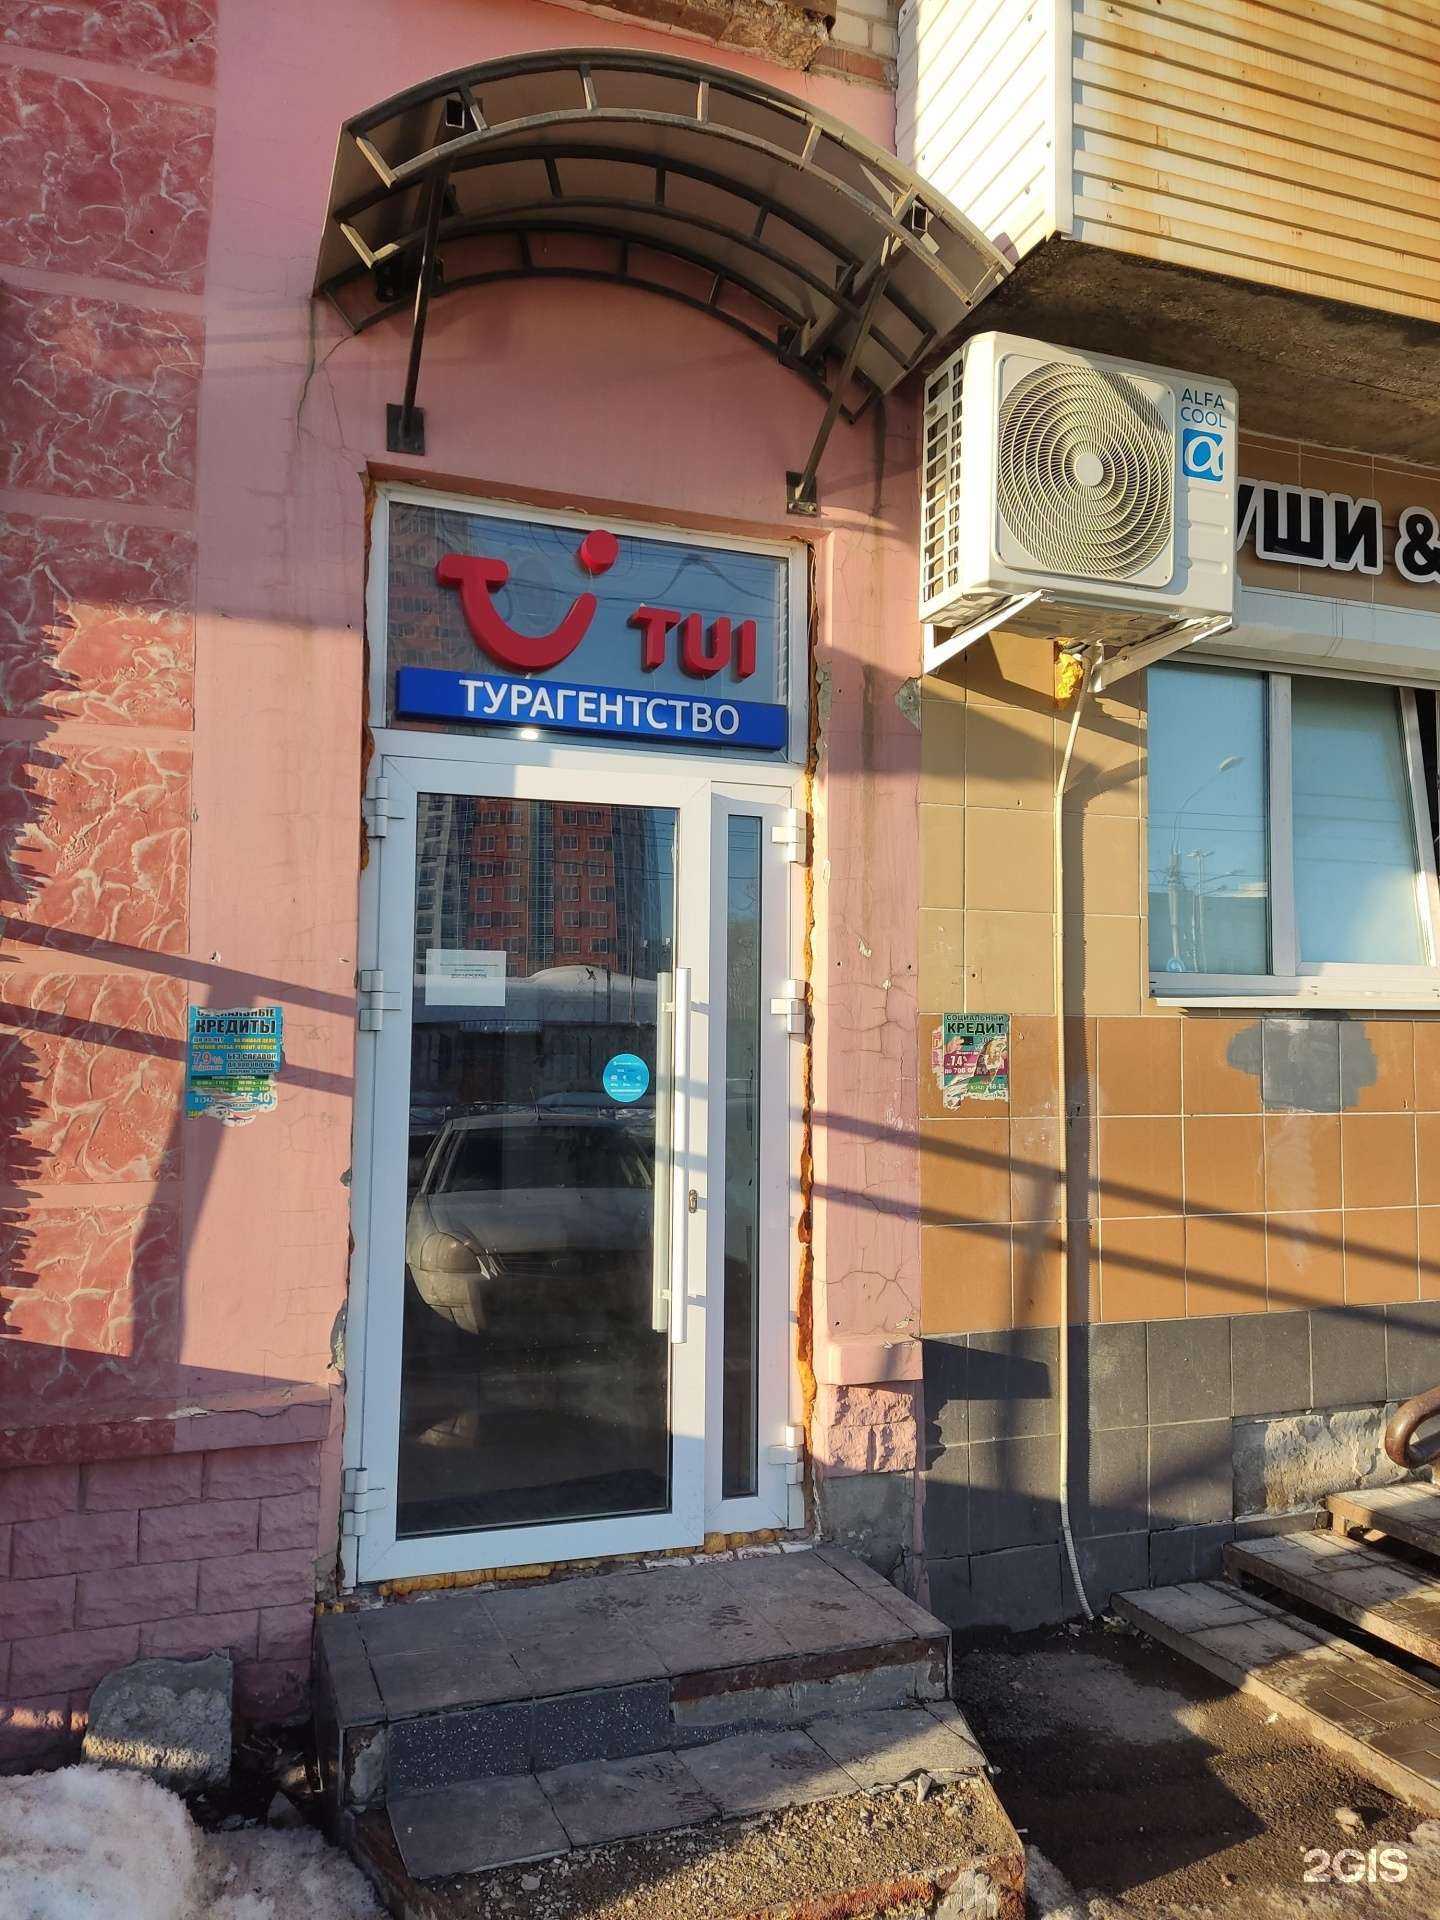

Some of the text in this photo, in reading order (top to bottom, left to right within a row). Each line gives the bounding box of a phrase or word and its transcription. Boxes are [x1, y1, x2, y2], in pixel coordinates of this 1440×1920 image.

[1181, 387, 1225, 410] ALFA
[1181, 406, 1227, 429] COOL
[628, 605, 757, 681] TUI
[458, 678, 740, 736] ТУРАГЕНТСТВО
[195, 1019, 276, 1034] КРЕДИТЫ
[947, 1022, 1004, 1035] КРЕДИТ
